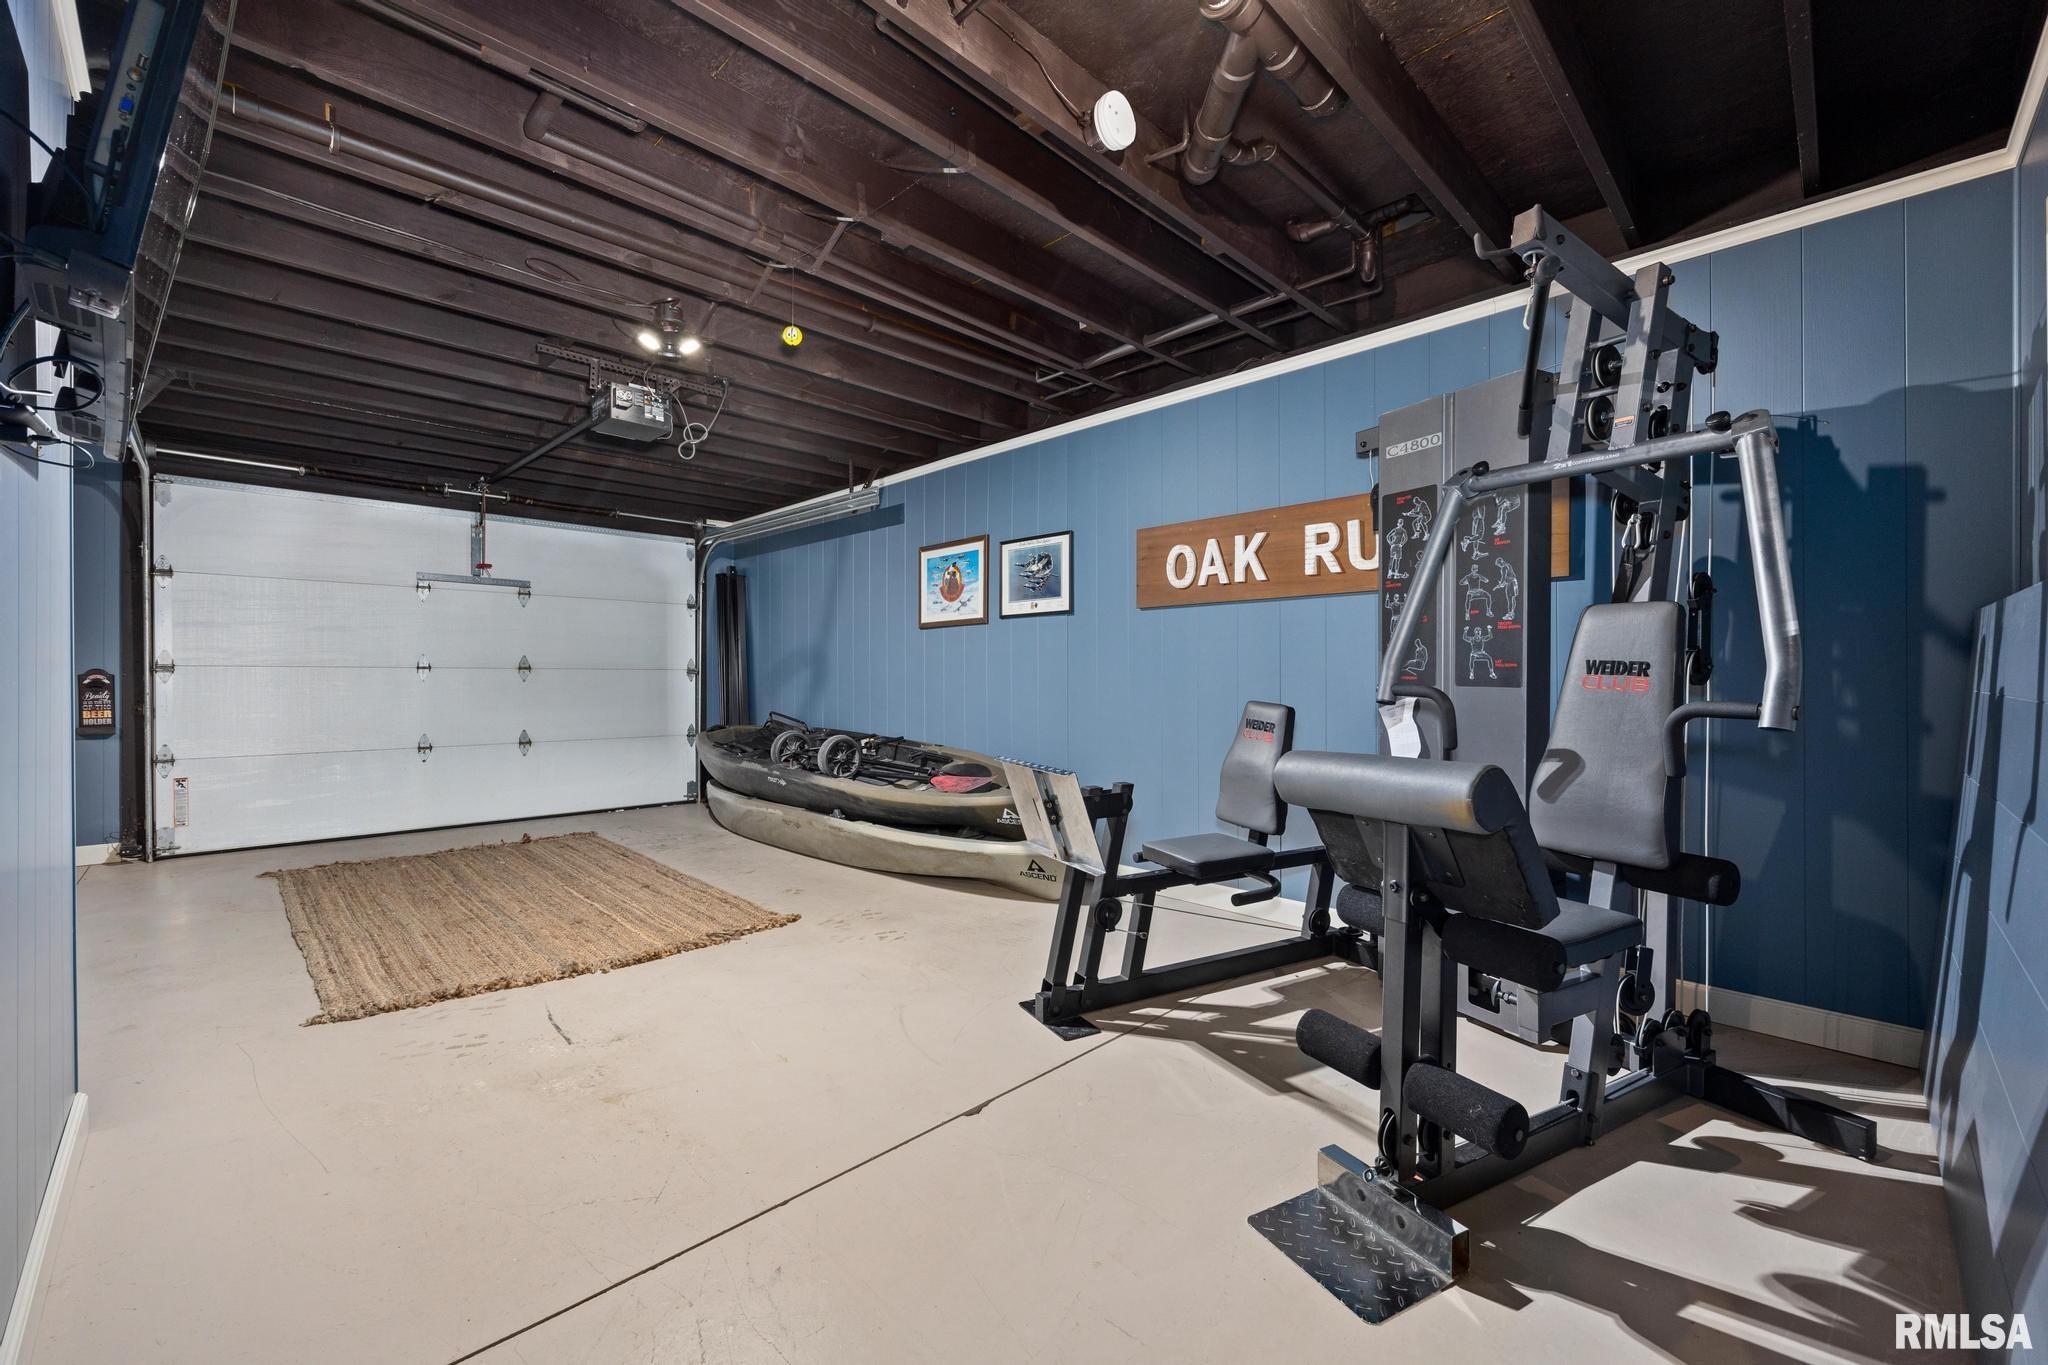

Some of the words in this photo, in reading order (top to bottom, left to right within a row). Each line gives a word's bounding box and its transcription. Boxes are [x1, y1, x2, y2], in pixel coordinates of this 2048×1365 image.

[1387, 434, 1440, 457] C4800
[1166, 531, 1268, 589] OAK
[1304, 519, 1380, 576] RU
[1585, 659, 1651, 677] WEIDER
[1582, 674, 1649, 692] CLUB
[82, 710, 112, 718] BEER
[1246, 718, 1276, 733] WEIDER
[1020, 871, 1057, 882] ASCEND
